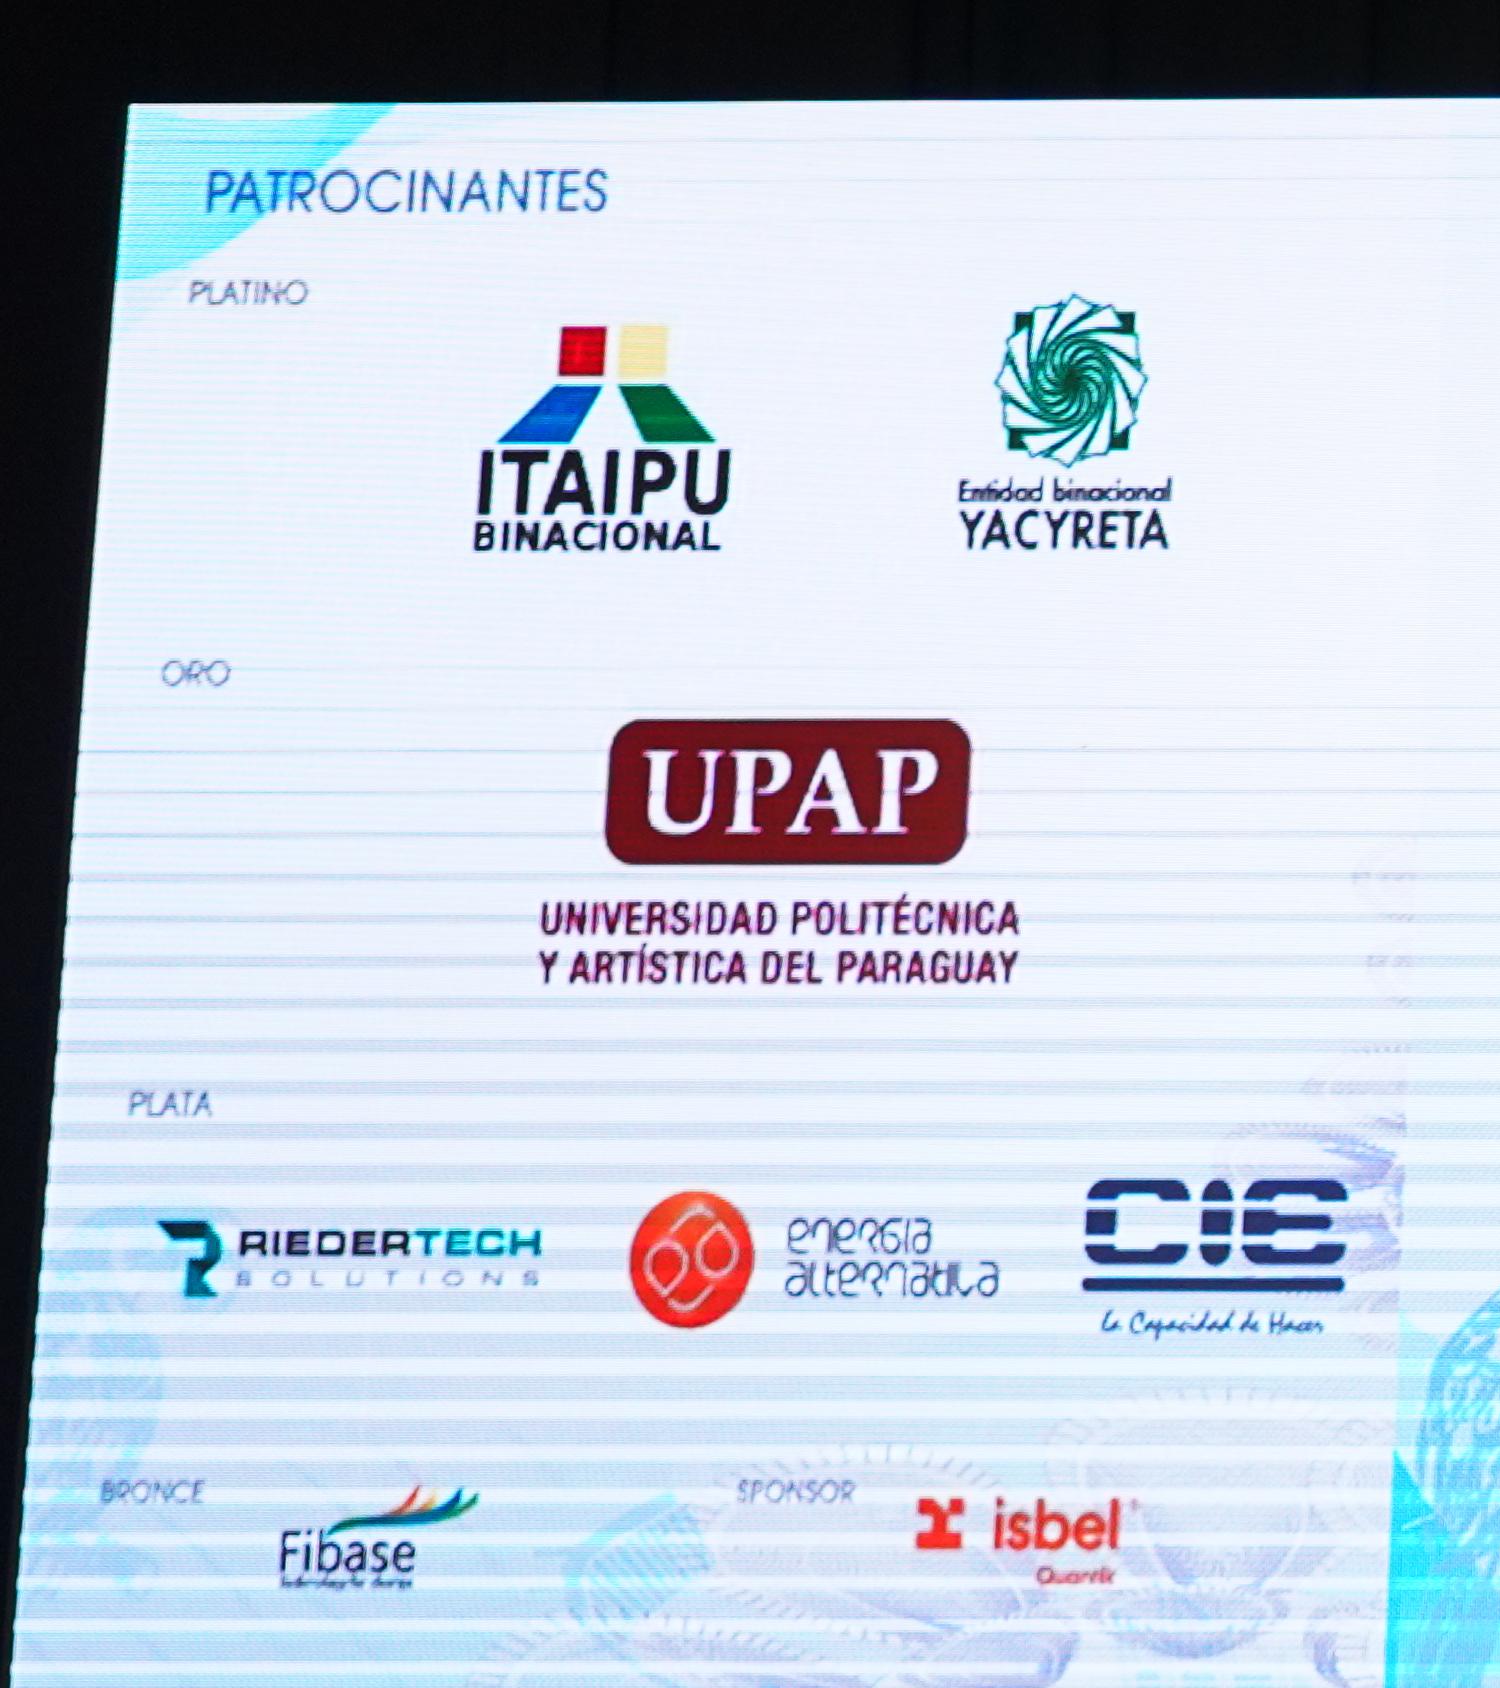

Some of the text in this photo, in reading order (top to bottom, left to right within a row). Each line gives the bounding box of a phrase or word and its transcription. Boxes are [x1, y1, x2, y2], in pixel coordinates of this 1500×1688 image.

[206, 169, 609, 213] PATROCINANTES
[189, 280, 309, 306] PLATINO
[476, 449, 731, 515] ITAIPU
[958, 476, 1173, 502] Entidad binacional
[472, 521, 722, 552] BINACIONAL
[959, 509, 1169, 550] YACYRETA
[161, 659, 231, 687] ORO
[644, 749, 939, 835] UPAP
[540, 892, 1019, 936] UNIVERSIDAD POLITÉCNICA
[539, 943, 1019, 985] Y ARTÍSTICA DEL PARAGUAY
[128, 1091, 214, 1119] PLATA
[1085, 1179, 1348, 1266] CIE
[240, 1230, 542, 1257] RIEDERTECH
[236, 1270, 539, 1287] SOLUTIONS
[1129, 1310, 1235, 1341] Capacidad
[1240, 1309, 1259, 1332] de
[1269, 1312, 1324, 1334] Hacer
[101, 1480, 205, 1504] BRONCE
[737, 1479, 856, 1503] SPONSOR
[994, 1497, 1121, 1551] isbel
[280, 1528, 416, 1572] Fibase
